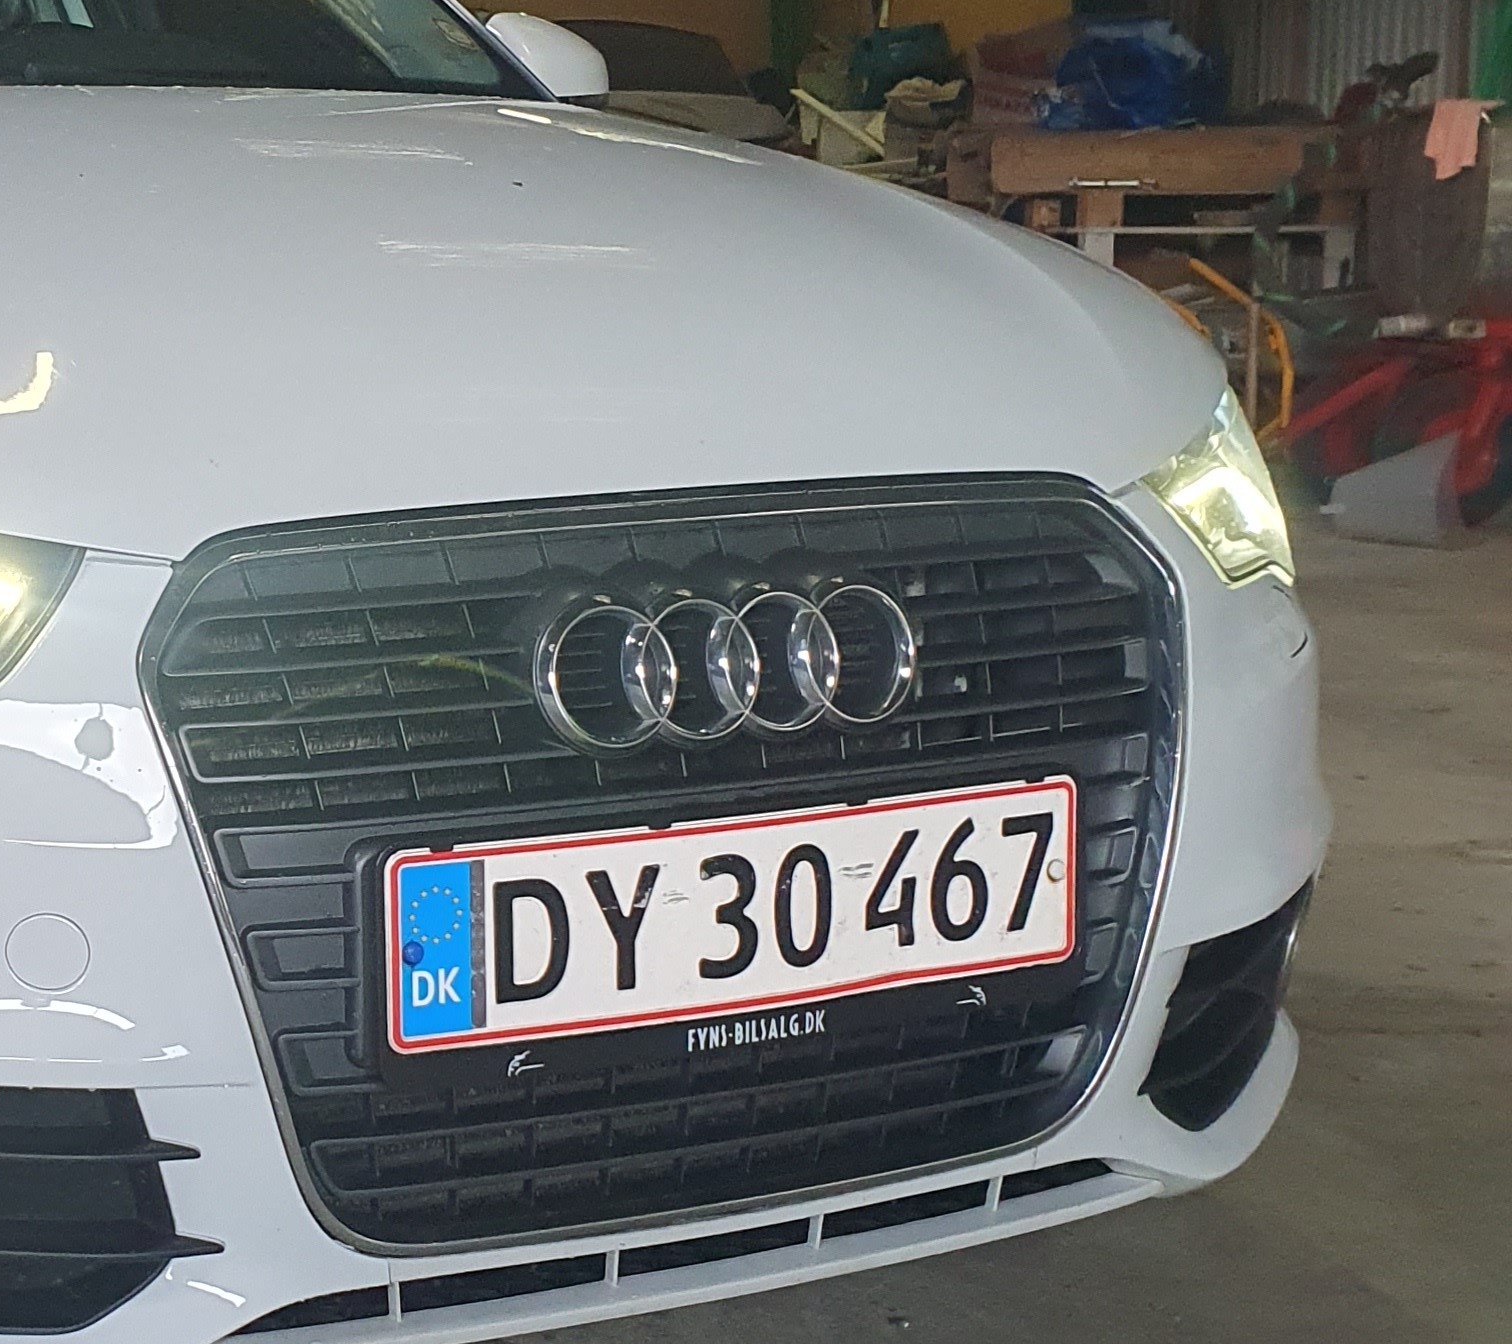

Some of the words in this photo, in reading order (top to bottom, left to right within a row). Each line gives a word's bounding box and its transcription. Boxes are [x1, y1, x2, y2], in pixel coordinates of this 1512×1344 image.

[493, 864, 660, 1004] DY
[699, 843, 832, 979] 30
[865, 812, 1054, 947] 467
[411, 966, 462, 1007] DK
[687, 1009, 826, 1052] FYNS-BILSALG.DK
